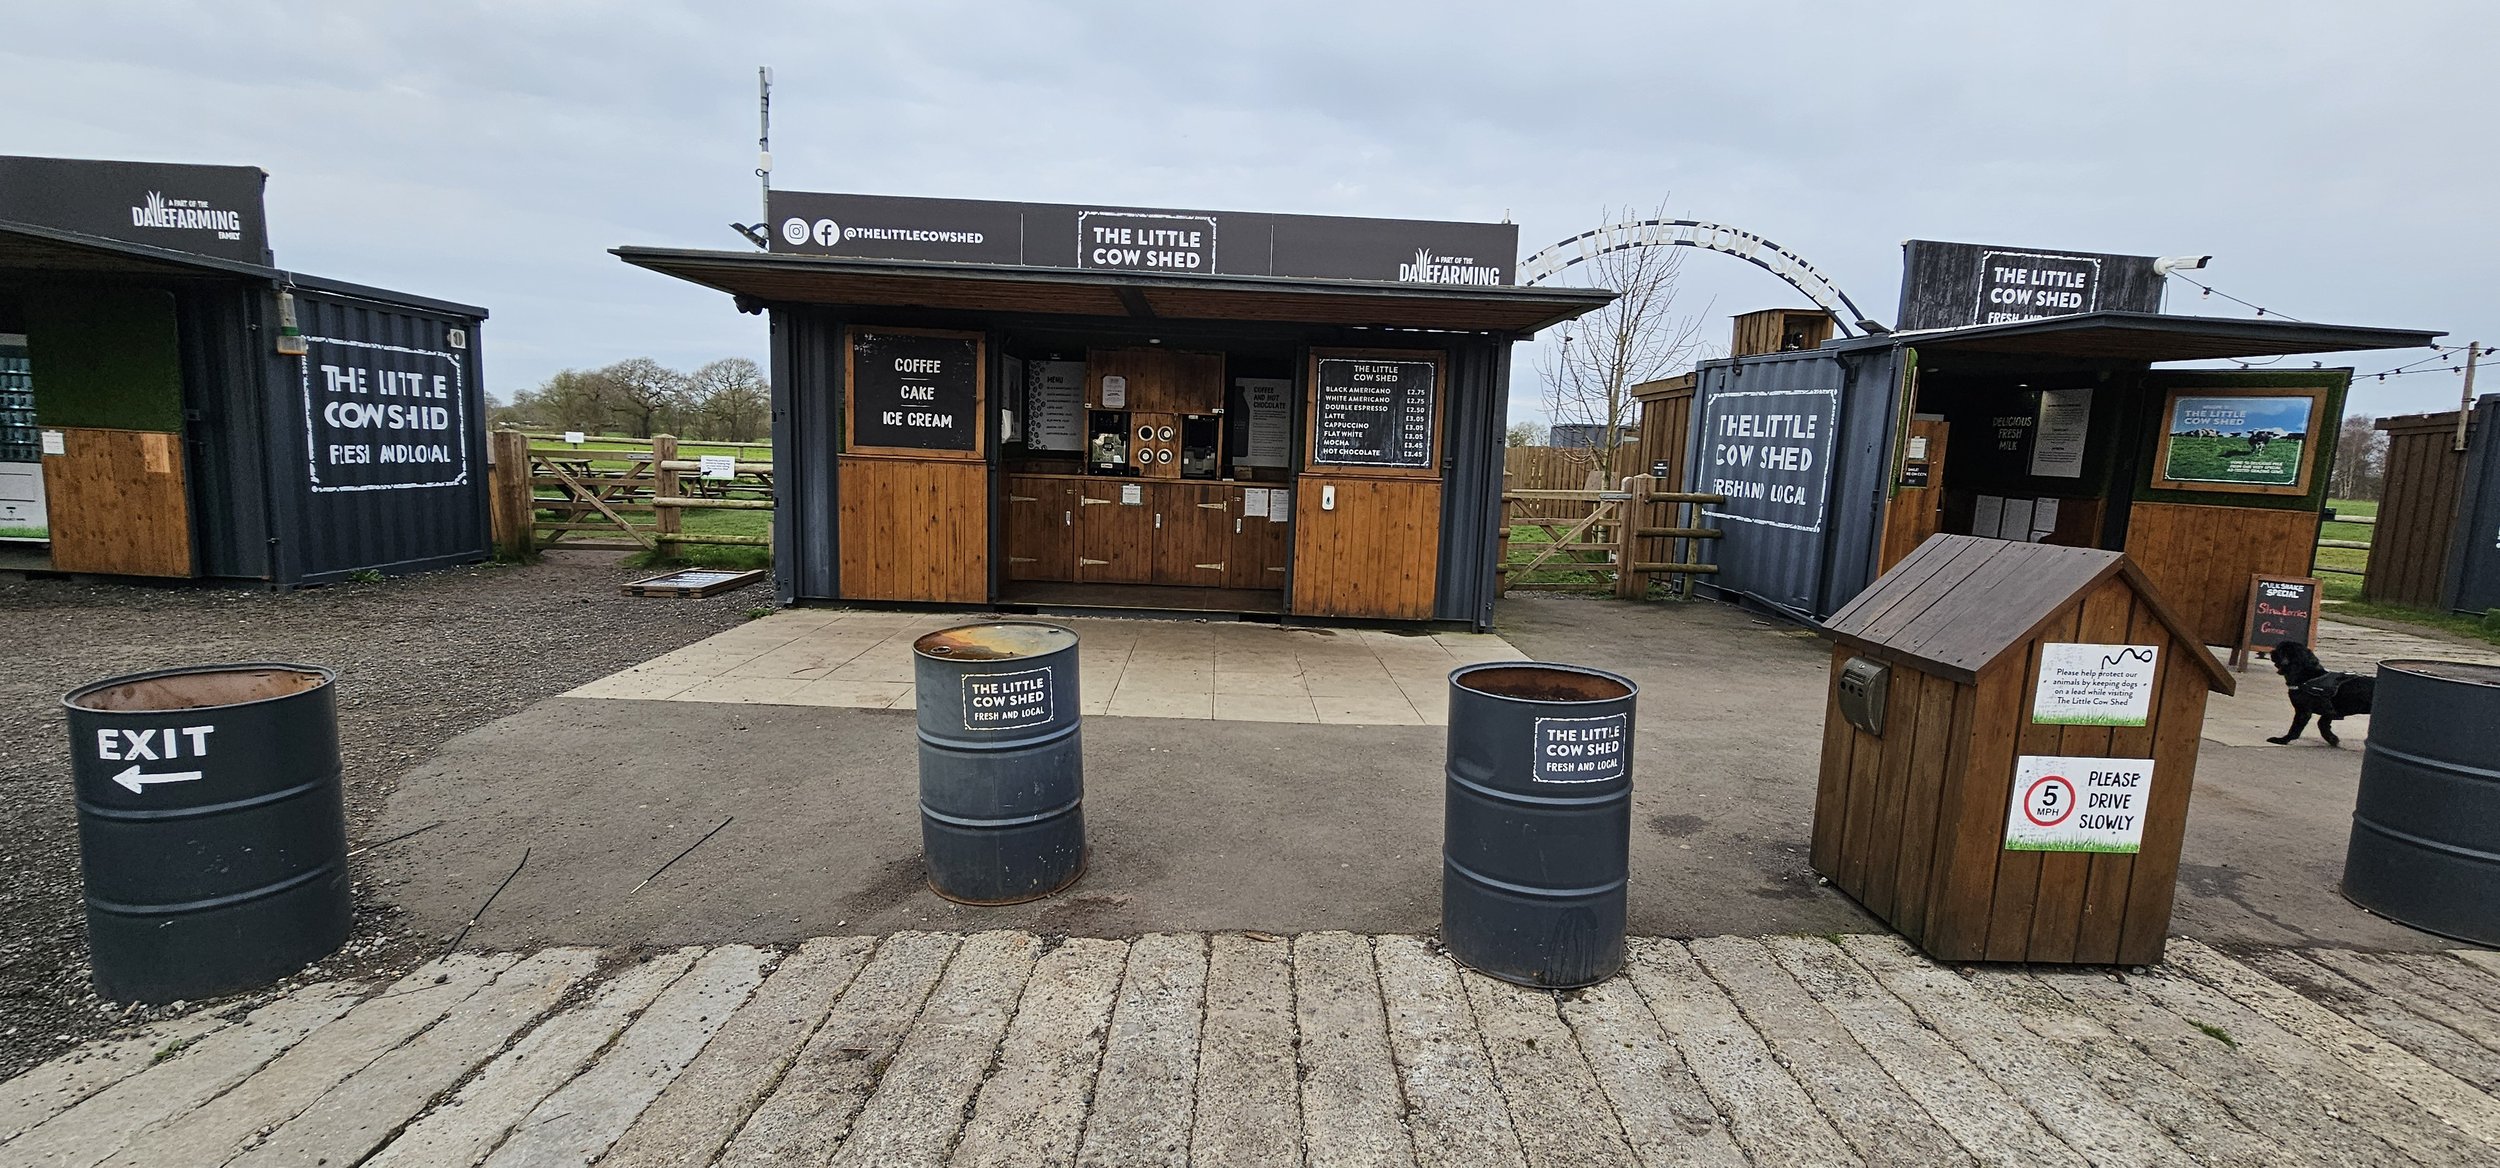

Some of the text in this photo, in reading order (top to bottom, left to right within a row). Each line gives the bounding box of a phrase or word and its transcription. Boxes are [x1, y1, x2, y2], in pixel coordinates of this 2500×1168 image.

[188, 200, 196, 208] OF
[197, 200, 208, 208] THE
[218, 231, 240, 240] FAMILY
[844, 227, 984, 244] @THELITTLECOWSHED
[1094, 227, 1200, 248] THE LITTLE
[1093, 248, 1200, 268] COW SHED
[1516, 218, 1841, 307] THE LITTLE COW SHED
[1995, 267, 2086, 288] THE LITTLE
[1990, 288, 2082, 308] COW SHED
[1988, 312, 2020, 324] FRESH
[894, 358, 941, 374] COFFEE
[1372, 366, 1398, 374] LITTLE
[320, 364, 447, 398] THE LITTE
[1376, 374, 1398, 382] SHED
[900, 385, 934, 400] CAKE
[1254, 386, 1274, 394] COFFEE
[324, 401, 385, 428] COW
[882, 411, 952, 428] ICE CREAM
[1992, 416, 2032, 427] DELICIOUS
[2185, 410, 2247, 418] THE LITTLE
[2213, 418, 2244, 426] SHED
[1720, 414, 1818, 438] THE LITTLE
[1998, 428, 2023, 439] FRESH
[408, 444, 451, 464] LOAL
[1716, 444, 1812, 471] COW SHED
[1770, 484, 1806, 506] LOCAL
[2266, 589, 2299, 598] SPECIAL
[2056, 668, 2079, 676] Please
[2080, 669, 2096, 679] help
[2098, 671, 2124, 679] protect
[972, 678, 1044, 694] THE LITTLE
[2053, 678, 2138, 689] animals by keeping dogs
[972, 691, 1044, 707] COW SHED
[2108, 689, 2133, 699] visiting
[974, 706, 1044, 721] FRESH AND LOCAL
[1547, 726, 1620, 741] THE LITTLE
[97, 725, 214, 760] EXIT
[1546, 740, 1619, 756] COW SHED
[1546, 758, 1618, 772] FRESH AND LOCAL
[2088, 771, 2140, 787] PLEASE
[2042, 785, 2059, 806] 5
[2089, 793, 2132, 809] DRIVE
[2037, 808, 2059, 816] MPH
[2079, 814, 2134, 831] SLOWLY
